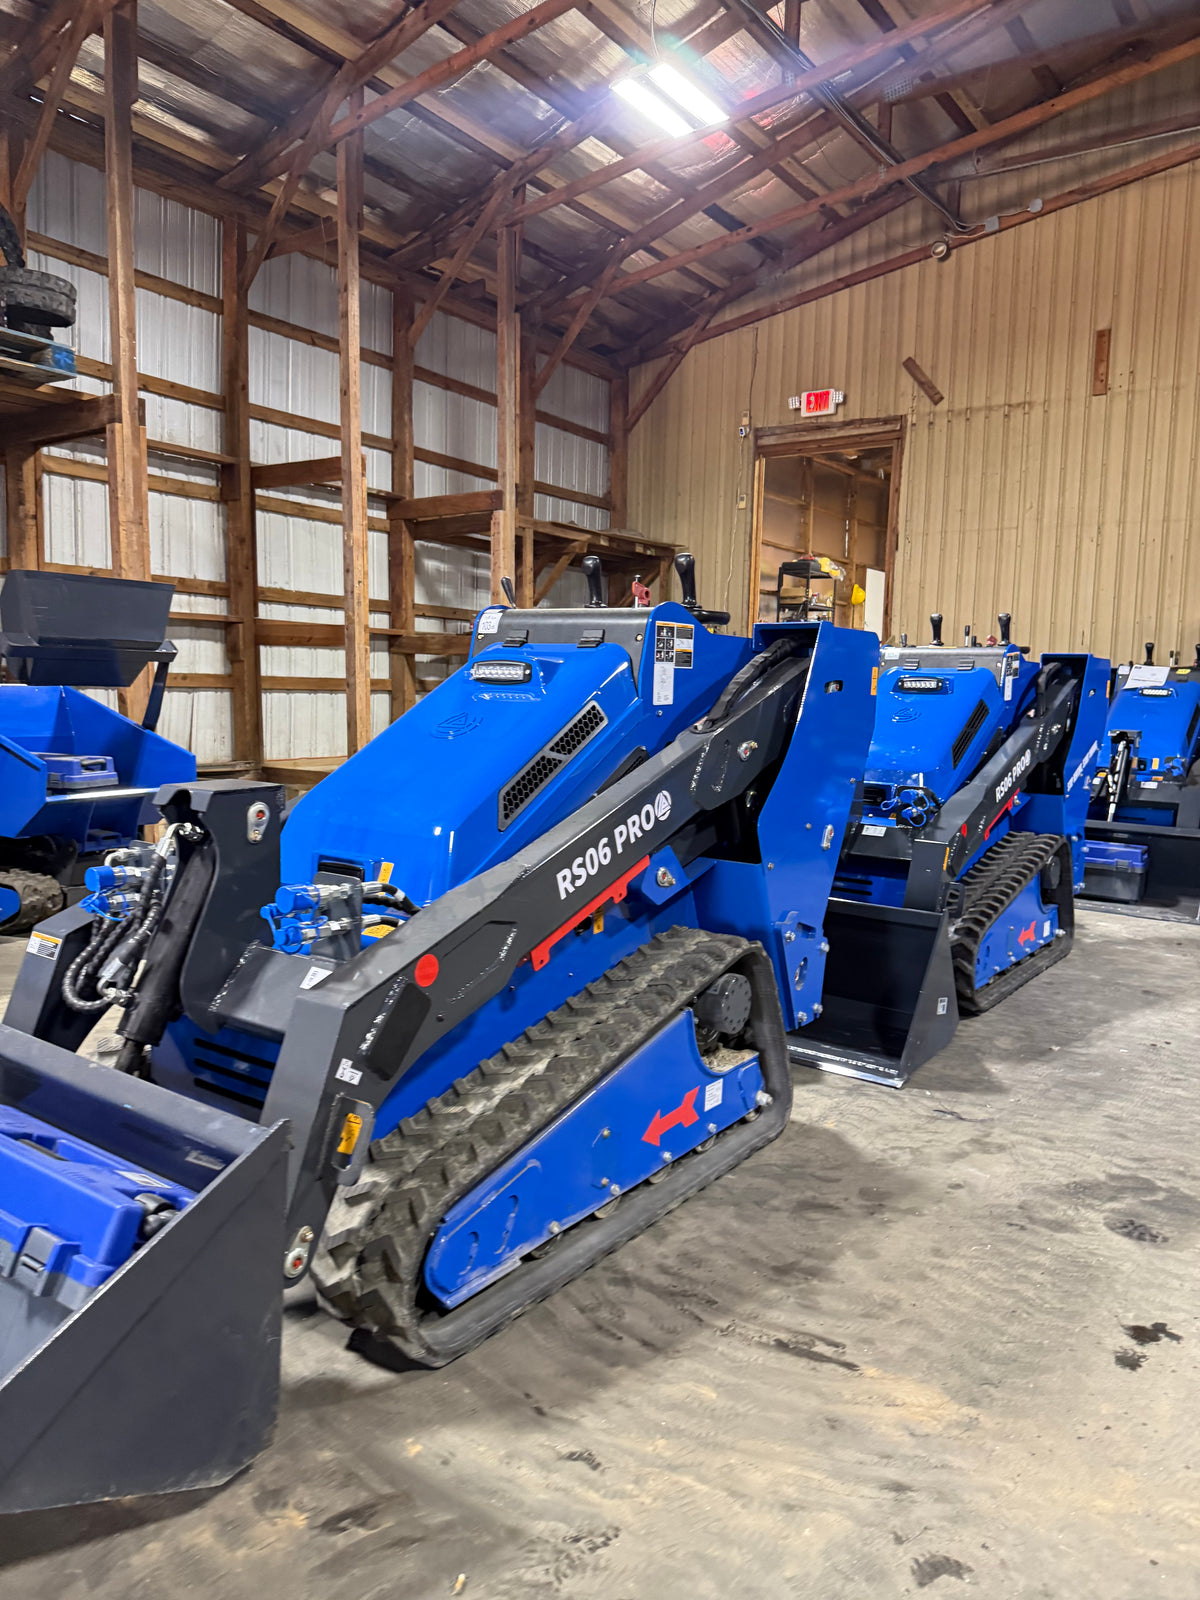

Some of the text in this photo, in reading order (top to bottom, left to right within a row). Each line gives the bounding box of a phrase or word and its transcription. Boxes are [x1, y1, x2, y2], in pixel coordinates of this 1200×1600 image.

[806, 391, 830, 413] EXIT
[995, 756, 1025, 803] RS06 PRO
[556, 804, 655, 900] RS06 PRO
